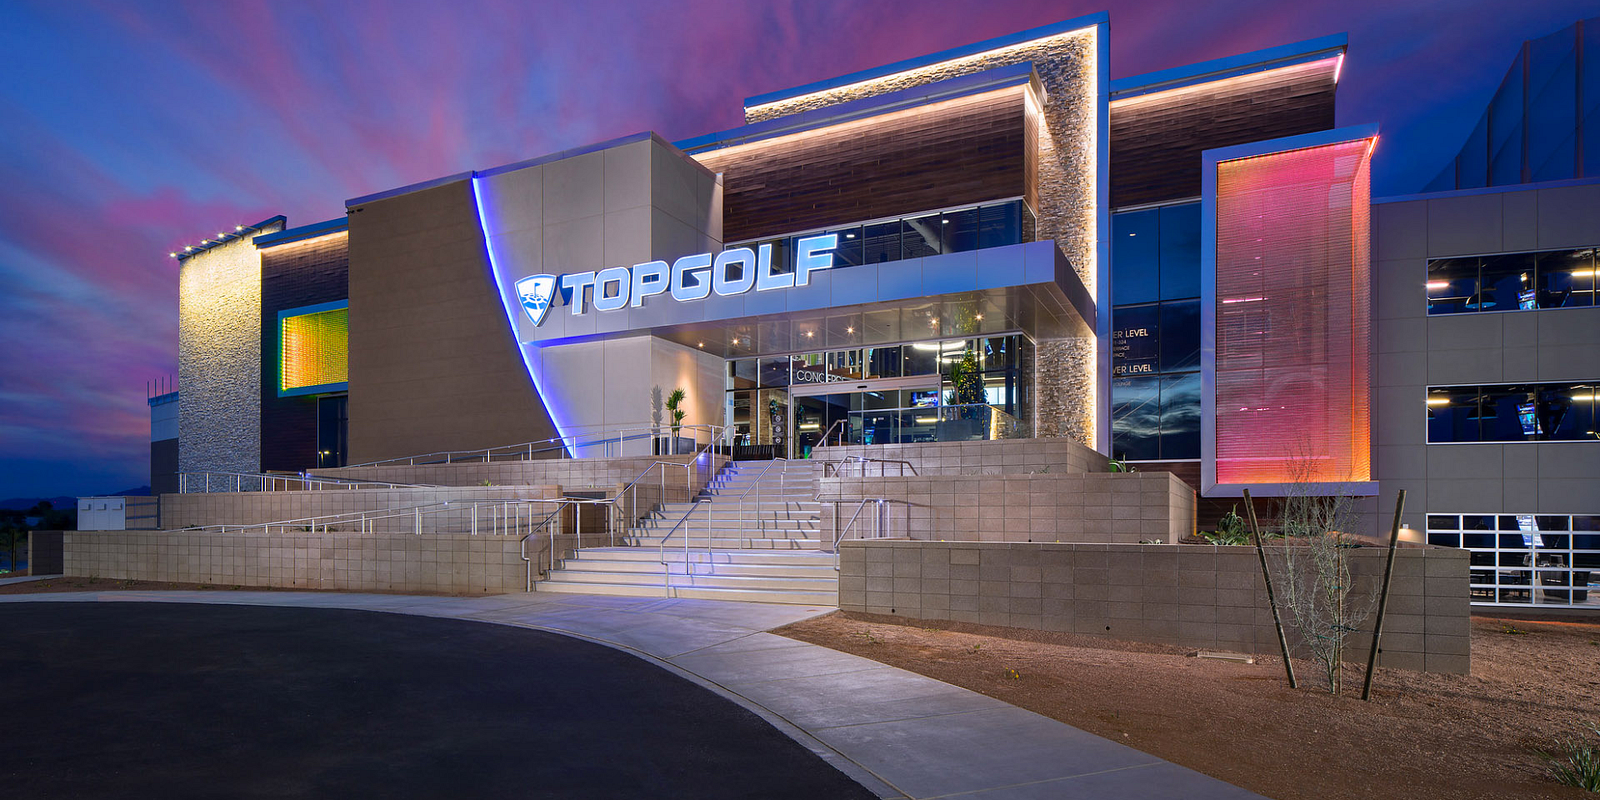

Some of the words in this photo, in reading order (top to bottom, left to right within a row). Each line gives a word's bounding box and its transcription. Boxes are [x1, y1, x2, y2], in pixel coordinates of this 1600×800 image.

[562, 233, 838, 315] TOPGOLF
[1125, 328, 1148, 338] LEVEL
[1129, 364, 1152, 373] LEVEL
